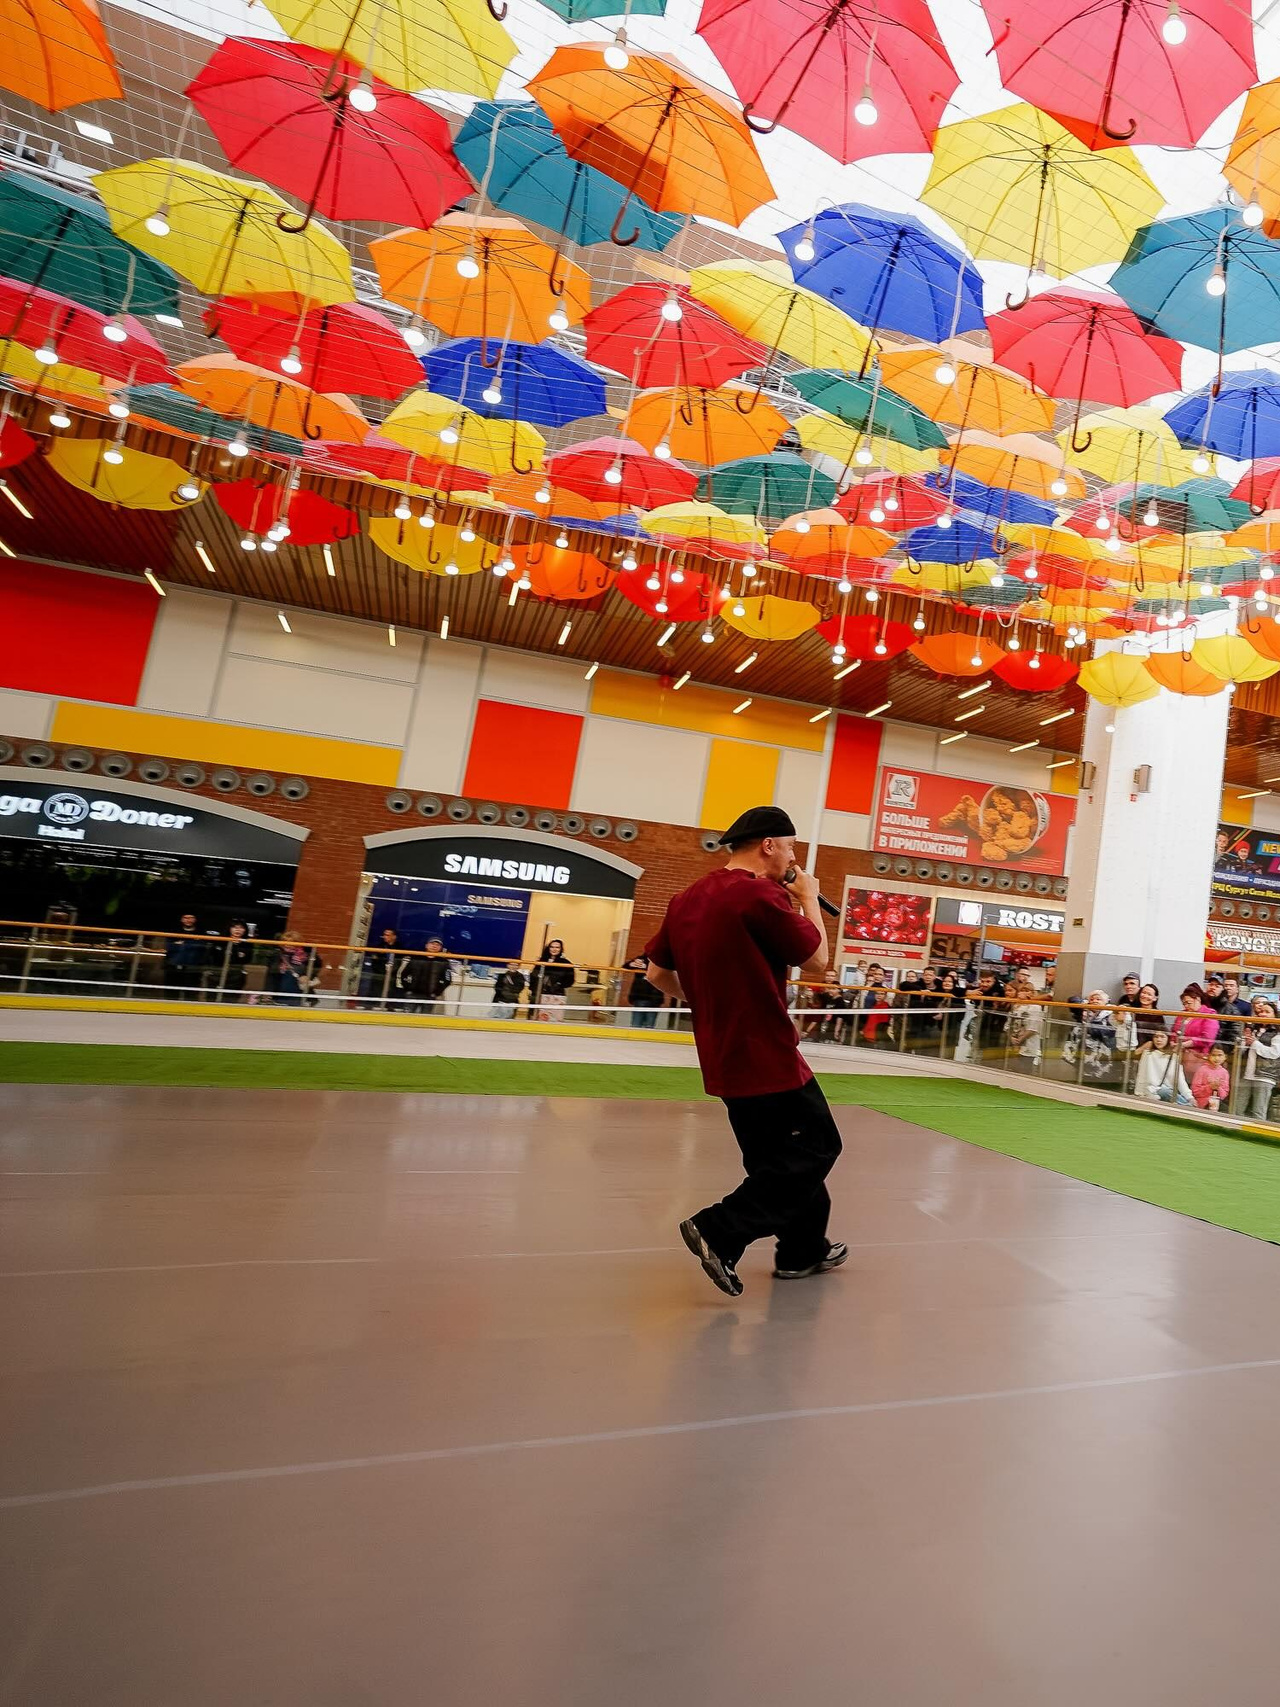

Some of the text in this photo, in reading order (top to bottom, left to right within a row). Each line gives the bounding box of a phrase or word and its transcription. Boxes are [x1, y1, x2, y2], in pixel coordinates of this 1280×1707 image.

[89, 800, 194, 830] Doner
[881, 812, 930, 830] БОЛЬШЕ
[878, 835, 967, 858] В ПРИЛОЖЕНИИ
[444, 853, 570, 885] SAMSUNG
[467, 894, 523, 908] SAMSUNG
[1216, 934, 1266, 952] KONG
